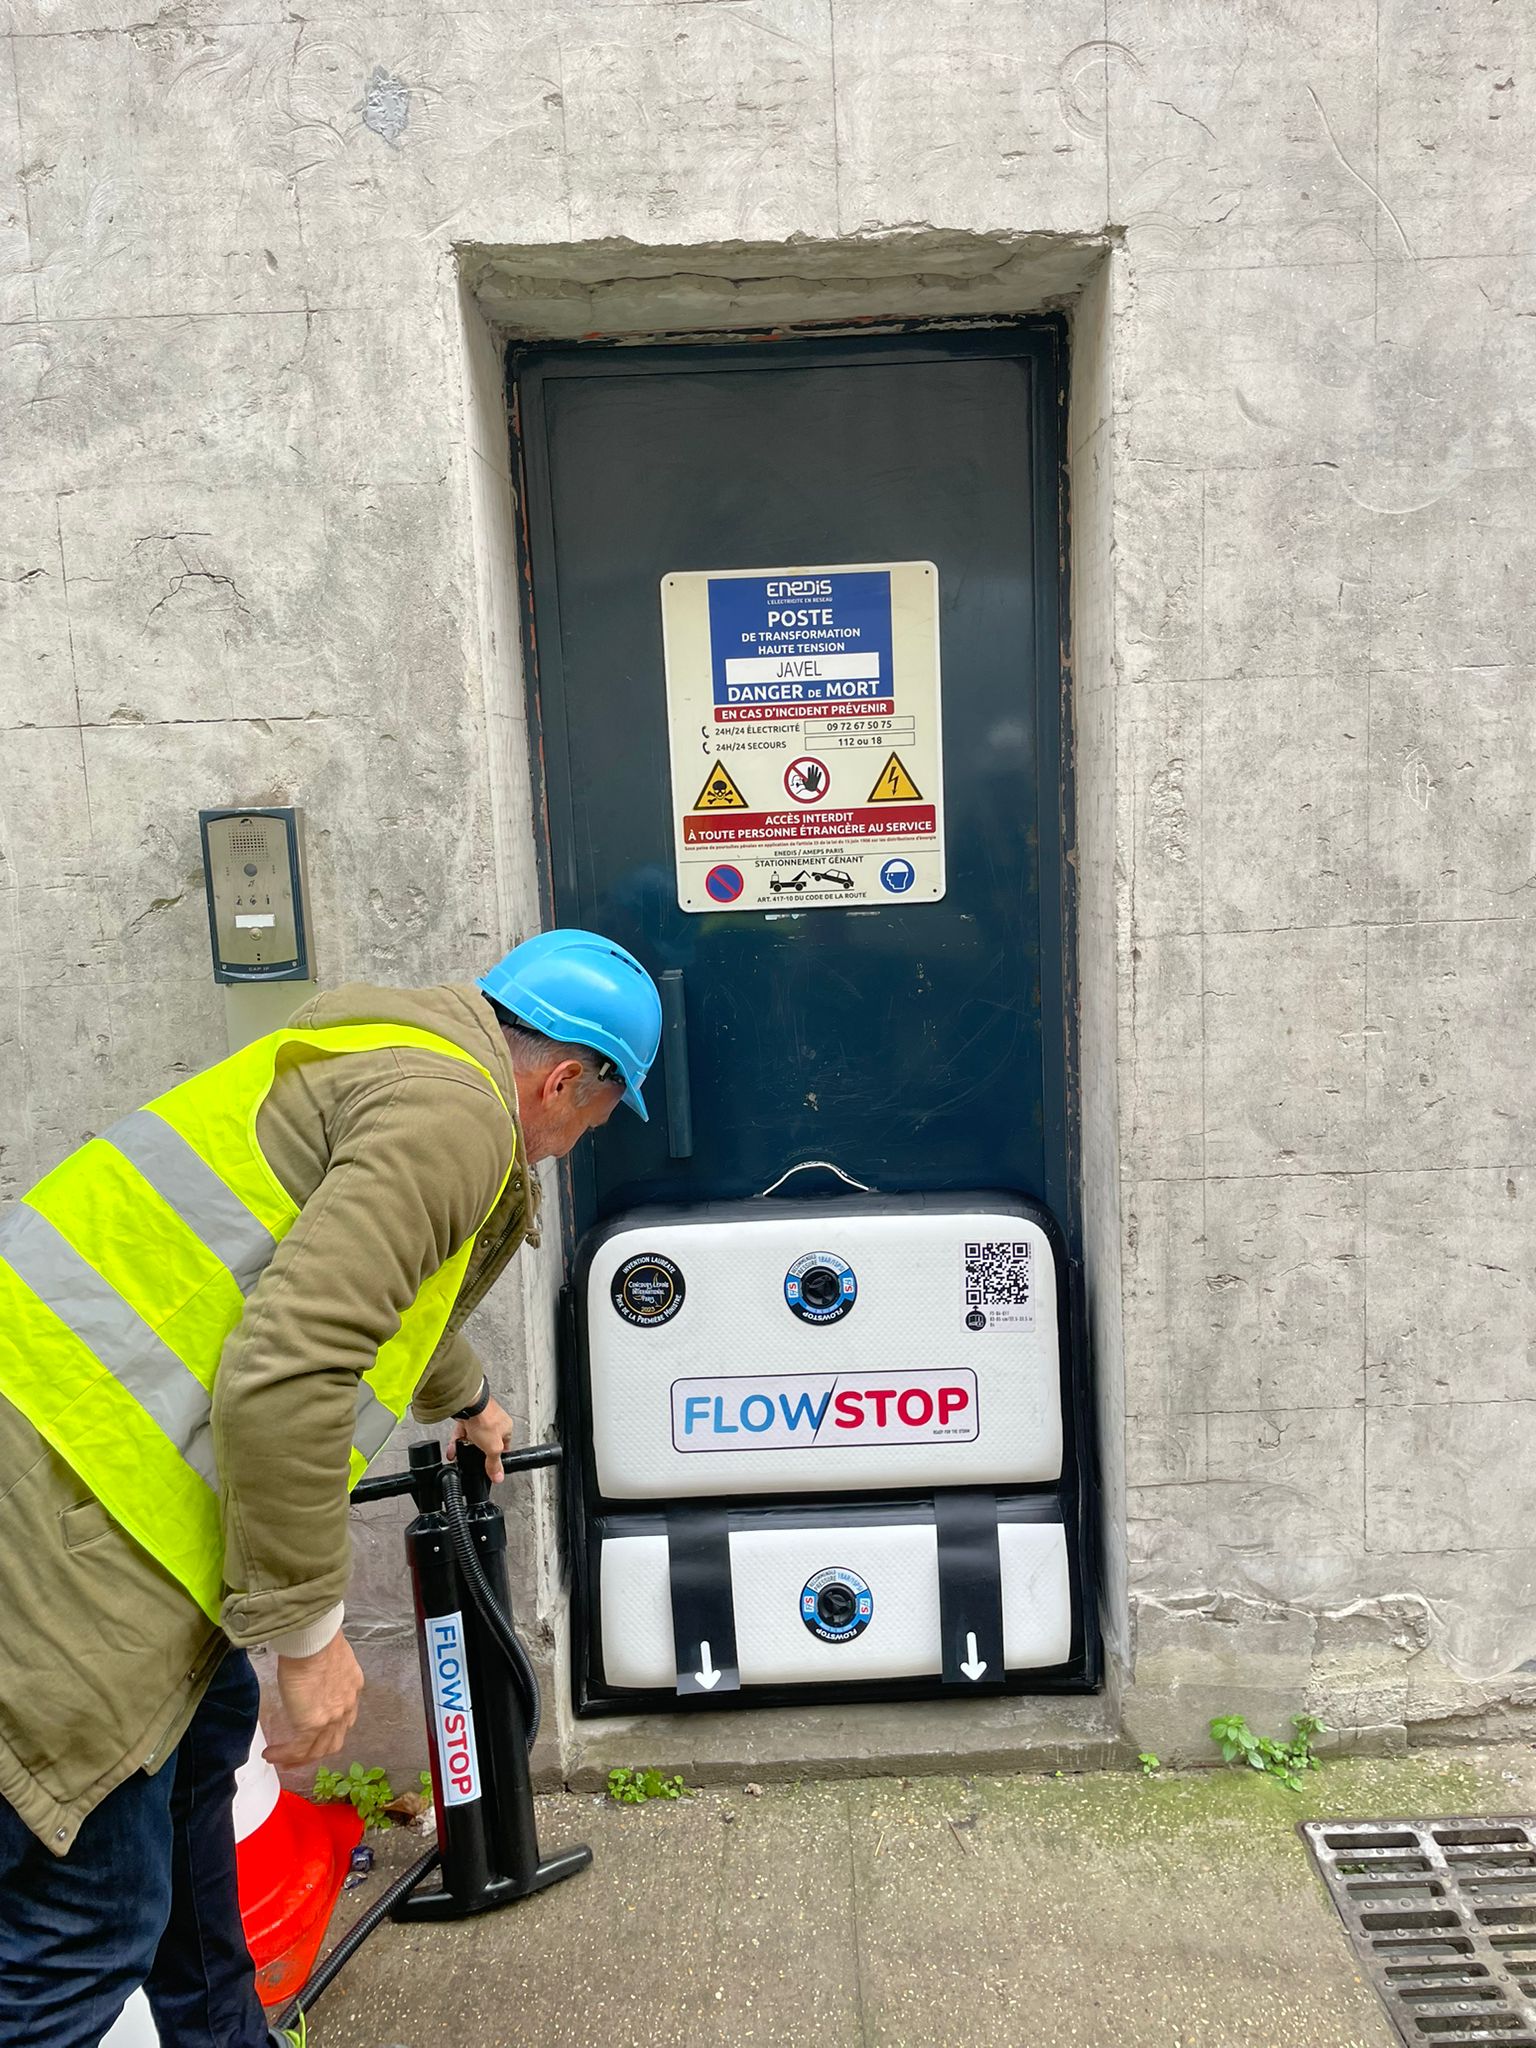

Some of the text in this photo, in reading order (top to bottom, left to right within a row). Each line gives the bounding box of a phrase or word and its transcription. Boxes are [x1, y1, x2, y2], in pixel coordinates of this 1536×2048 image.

[768, 608, 833, 628] POSTE
[742, 628, 861, 642] DE TRANSFORMATION
[758, 642, 845, 655] HAUTE TENSION
[776, 661, 822, 678] JAVEL
[728, 681, 880, 702] DANGER DE MORT
[722, 702, 887, 719] EN CAS D'INCIDENT PRÉVENIR
[715, 723, 800, 736] 24H/24 ÉLECTRICITÉ
[827, 720, 892, 731] 09 72 67 50 75
[716, 741, 787, 752] 24H/24 SECOURS
[838, 738, 854, 746] 112
[872, 736, 882, 745] 18
[765, 812, 855, 825] ACCÈS INTERDIT
[688, 821, 933, 841] À TOUTE PERSONNE ÉTRANGÈRE AU SERVICE
[755, 857, 826, 868] STATIONNEMENT
[773, 894, 794, 902] 417-10
[845, 892, 867, 900] ROUTE
[622, 1257, 650, 1274] INVENTION
[621, 1306, 631, 1316] DE
[628, 1313, 637, 1321] LA
